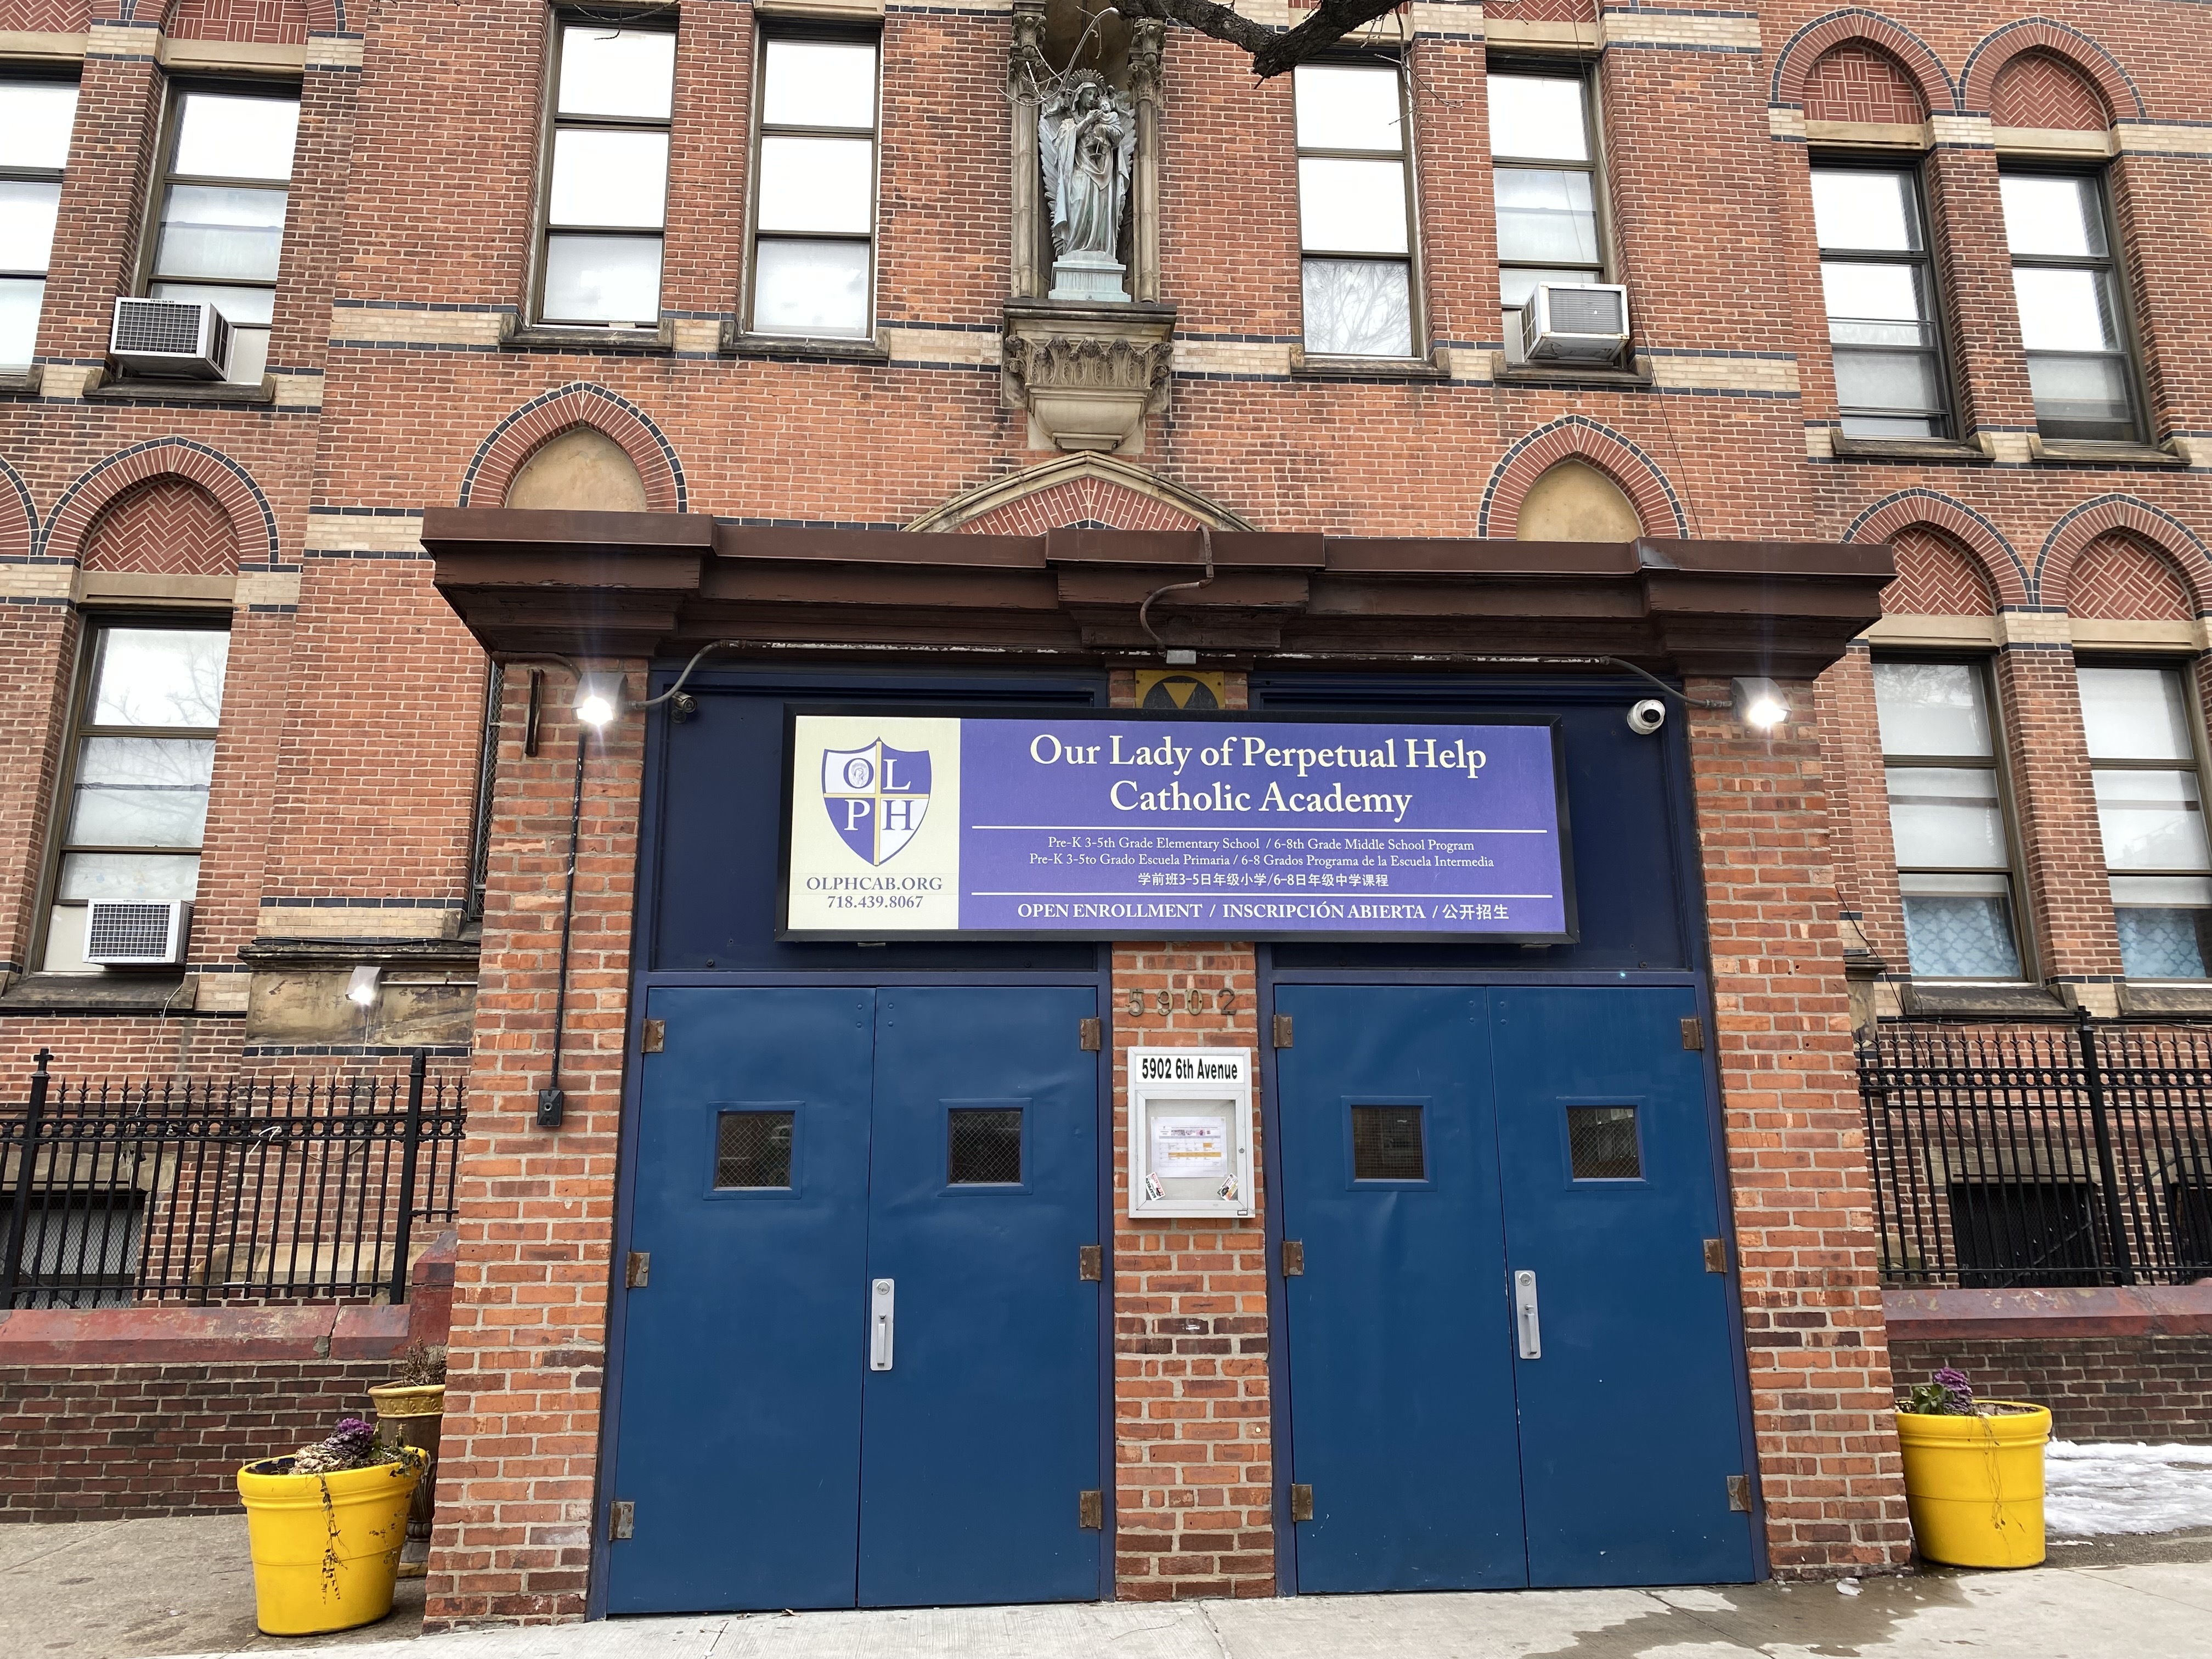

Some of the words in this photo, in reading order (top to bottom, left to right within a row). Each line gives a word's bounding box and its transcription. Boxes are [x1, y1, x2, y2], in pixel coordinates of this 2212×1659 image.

[1030, 734, 1101, 765] Our
[1109, 735, 1193, 776] Lady
[1200, 736, 1238, 766] of
[1241, 737, 1398, 777] Perpetual
[1404, 738, 1486, 778] Help
[1110, 780, 1251, 812] Catholic
[1258, 781, 1413, 823] Academy
[1048, 836, 1082, 848] Pre-K
[1085, 837, 1116, 848] 3-5th
[1119, 837, 1153, 849] Grade
[1156, 837, 1220, 852] Elementary
[1222, 837, 1260, 849] School
[1274, 838, 1305, 850] 6-8th
[1307, 838, 1342, 850] Grade
[1344, 838, 1385, 850] Middle
[1388, 838, 1425, 850] School
[1427, 839, 1475, 854] Program
[1029, 853, 1064, 865] Pre-K
[1066, 853, 1097, 865] 3-5to
[1099, 853, 1135, 865] Grado
[1138, 854, 1181, 866] Escuela
[1183, 854, 1231, 866] Primaria
[1241, 854, 1260, 865] 6-8
[1263, 854, 1304, 866] Grados
[1306, 855, 1359, 870] Programa
[1362, 855, 1375, 867] de
[1377, 855, 1387, 867] la
[1390, 855, 1432, 867] Escuela
[1434, 855, 1494, 867] Intermedia
[806, 877, 943, 890] OLPHCAB.ORG
[827, 895, 924, 909] 718.439.8067
[1018, 904, 1069, 918] OPEN
[1073, 904, 1203, 918] ENROLLMENT
[1222, 900, 1345, 919] INSCRIPCIÓN
[1347, 904, 1426, 919] ABIERTA
[1442, 904, 1509, 920] 公开招生
[1128, 988, 1237, 1017] 5902
[1142, 1057, 1172, 1079] 5902
[1175, 1058, 1193, 1079] 6th
[1197, 1058, 1238, 1080] Avenue
